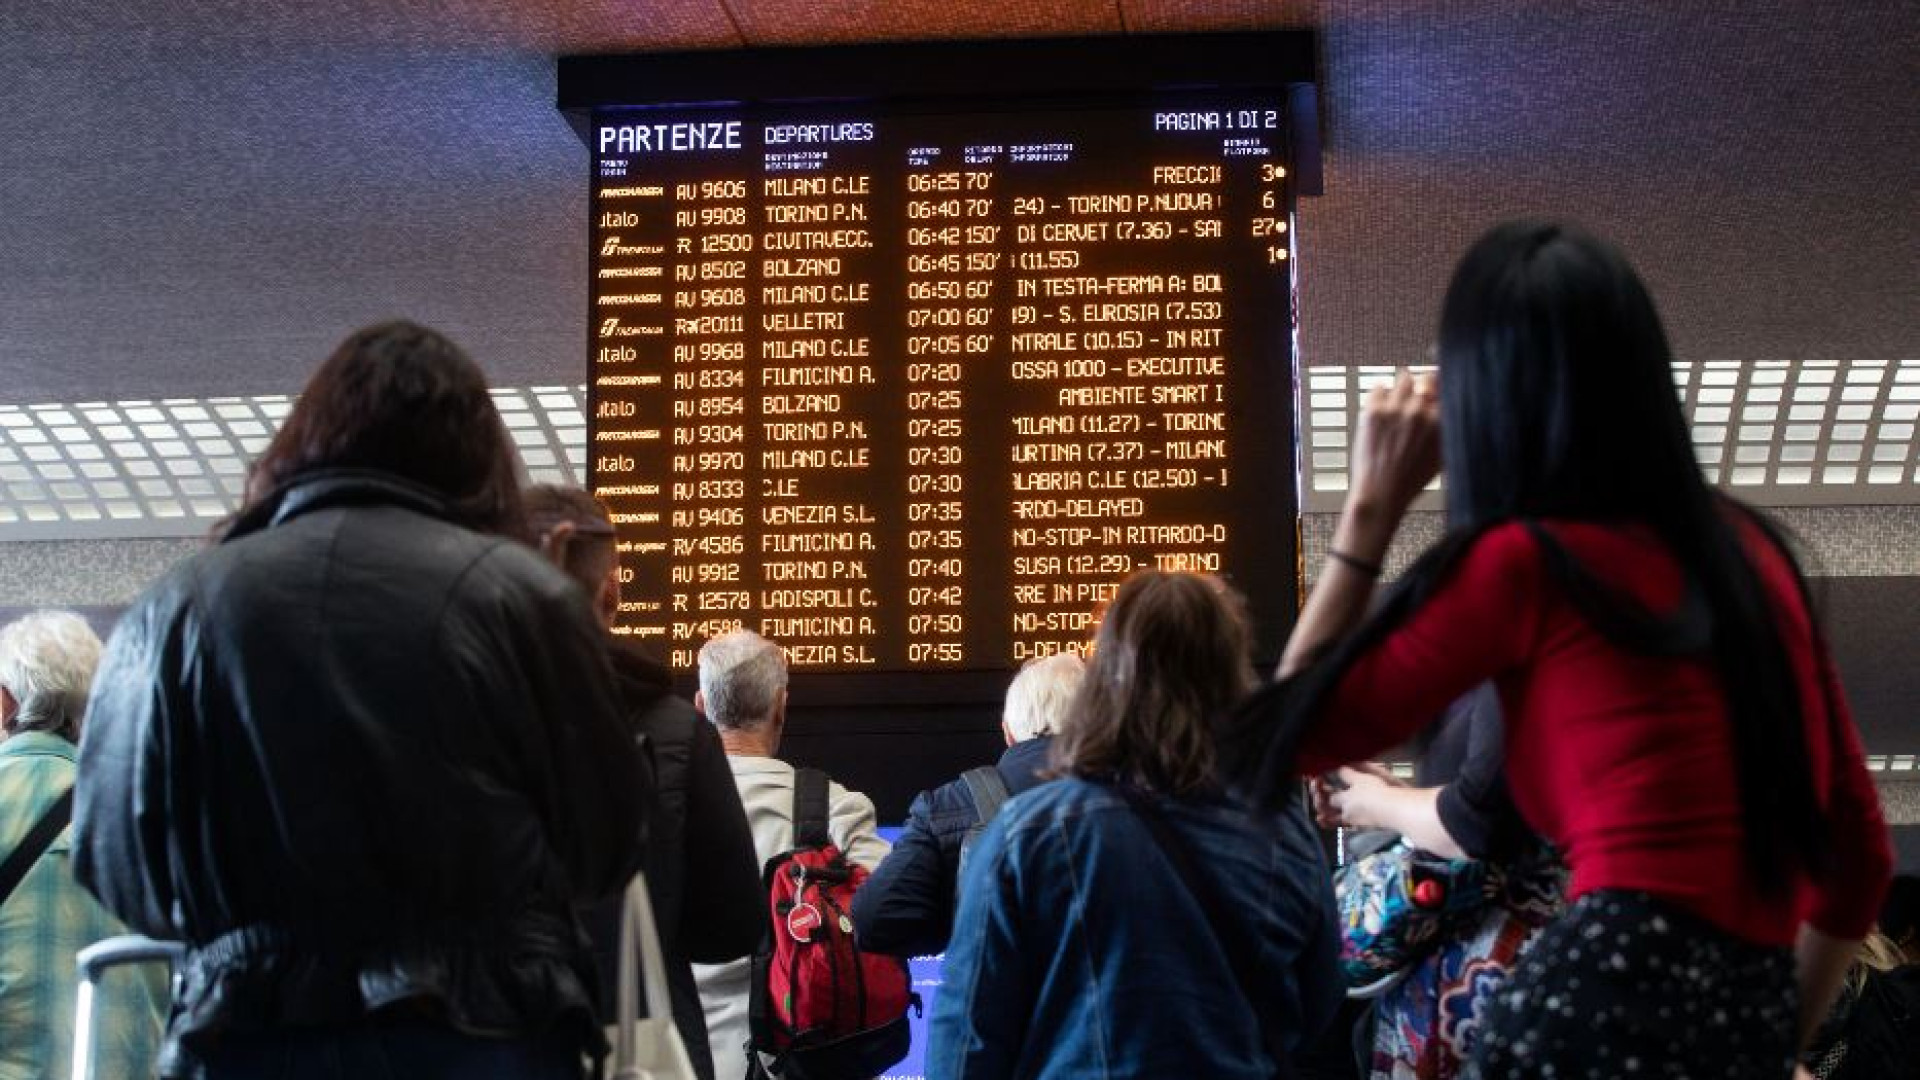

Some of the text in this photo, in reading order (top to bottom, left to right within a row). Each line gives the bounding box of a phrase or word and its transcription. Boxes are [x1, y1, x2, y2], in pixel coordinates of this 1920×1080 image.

[1156, 111, 1276, 130] PAGINA 1 DI 2
[601, 122, 741, 152] PARTENZE
[765, 123, 873, 144] DEPARTURES
[1263, 164, 1275, 181] 3
[677, 184, 697, 200] AV
[701, 181, 745, 199] 9606
[765, 177, 869, 196] MILANO C.LE
[908, 173, 959, 192] 06:25
[908, 199, 959, 218] 06:40
[1068, 195, 1132, 214] TORINO
[1138, 193, 1212, 212] P.NUOVA
[1263, 191, 1274, 208] 6
[677, 207, 745, 227] AV 9908
[765, 203, 867, 222] TORINO P.N.
[908, 226, 959, 245] 06:42
[1043, 222, 1109, 241] CERVET
[1117, 222, 1171, 239] (7.36)
[1253, 218, 1274, 236] 27
[677, 238, 692, 253] R
[702, 234, 753, 253] 12500
[763, 230, 873, 251] CIVITAVECC.
[763, 257, 840, 278] BOLZANO
[908, 253, 961, 272] 06:45
[1020, 251, 1079, 270] (11.55)
[675, 264, 696, 282] AV
[701, 261, 745, 280] 8502
[763, 284, 869, 305] MILANO C.LE
[908, 281, 961, 300] 06:50
[1017, 280, 1035, 296] IN
[1042, 275, 1163, 296] TESTA-FERMA
[1169, 275, 1186, 292] A:
[675, 292, 696, 309] AV
[700, 288, 745, 307] 9608
[763, 312, 844, 332] VELLETRI
[908, 308, 961, 327] 07:00
[1060, 306, 1076, 323] S.
[1084, 303, 1159, 321] EUROSIA
[1167, 302, 1221, 319] (7.53)
[763, 339, 869, 358] MILANO C.LE
[908, 335, 961, 354] 07:05
[1084, 331, 1142, 350] (10.15)
[1167, 331, 1186, 348] IN
[675, 341, 745, 362] AV 9968
[763, 366, 875, 387] FIUMICINO A.
[907, 364, 961, 382] 07:20
[1012, 356, 1224, 379] OSSA 1000 EXECUTIVE
[675, 372, 694, 389] AV
[699, 370, 743, 389] 8334
[763, 395, 840, 414] BOLZANO
[908, 391, 961, 410] 07:25
[1059, 385, 1146, 406] AMBIENTE
[1152, 384, 1208, 403] SMART
[675, 397, 743, 418] AV 8954
[763, 421, 867, 441] TORINO P.N.
[909, 419, 961, 436] 07:25
[1080, 414, 1140, 432] (11.27)
[675, 428, 694, 445] AV
[699, 424, 743, 443] 9304
[763, 448, 869, 469] MILANO C.LE
[909, 446, 961, 465] 07:30
[1088, 442, 1144, 461] (7.37)
[673, 452, 743, 473] AV 9970
[909, 475, 961, 494] 07:30
[1088, 471, 1126, 489] C.LE
[1134, 469, 1196, 488] (12.50)
[673, 483, 694, 500] AV
[699, 479, 743, 498] 8333
[673, 510, 694, 528] AV
[698, 508, 743, 527] 9406
[763, 504, 875, 525] VENEZIA S.L.
[909, 502, 961, 521] 07:35
[698, 535, 743, 554] 4586
[761, 532, 875, 552] FIUMICINO A.
[909, 530, 961, 549] 07:35
[1012, 524, 1225, 547] NO-STOP-IN RITARDO-D
[673, 563, 739, 584] AV 9912
[762, 561, 867, 581] TORINO P.N.
[909, 559, 961, 576] 07:40
[1014, 553, 1219, 576] SUSA (12.29) TORINO
[673, 594, 688, 611] R
[698, 591, 751, 609] 12578
[761, 588, 877, 609] LADISPOLI C.
[909, 586, 961, 605] 07:42
[1053, 584, 1073, 603] IN
[762, 617, 875, 638] FIUMICINO A.
[909, 615, 961, 634] 07:50
[673, 650, 692, 667] AV
[842, 646, 875, 663] S.L.
[909, 644, 961, 662] 07:55
